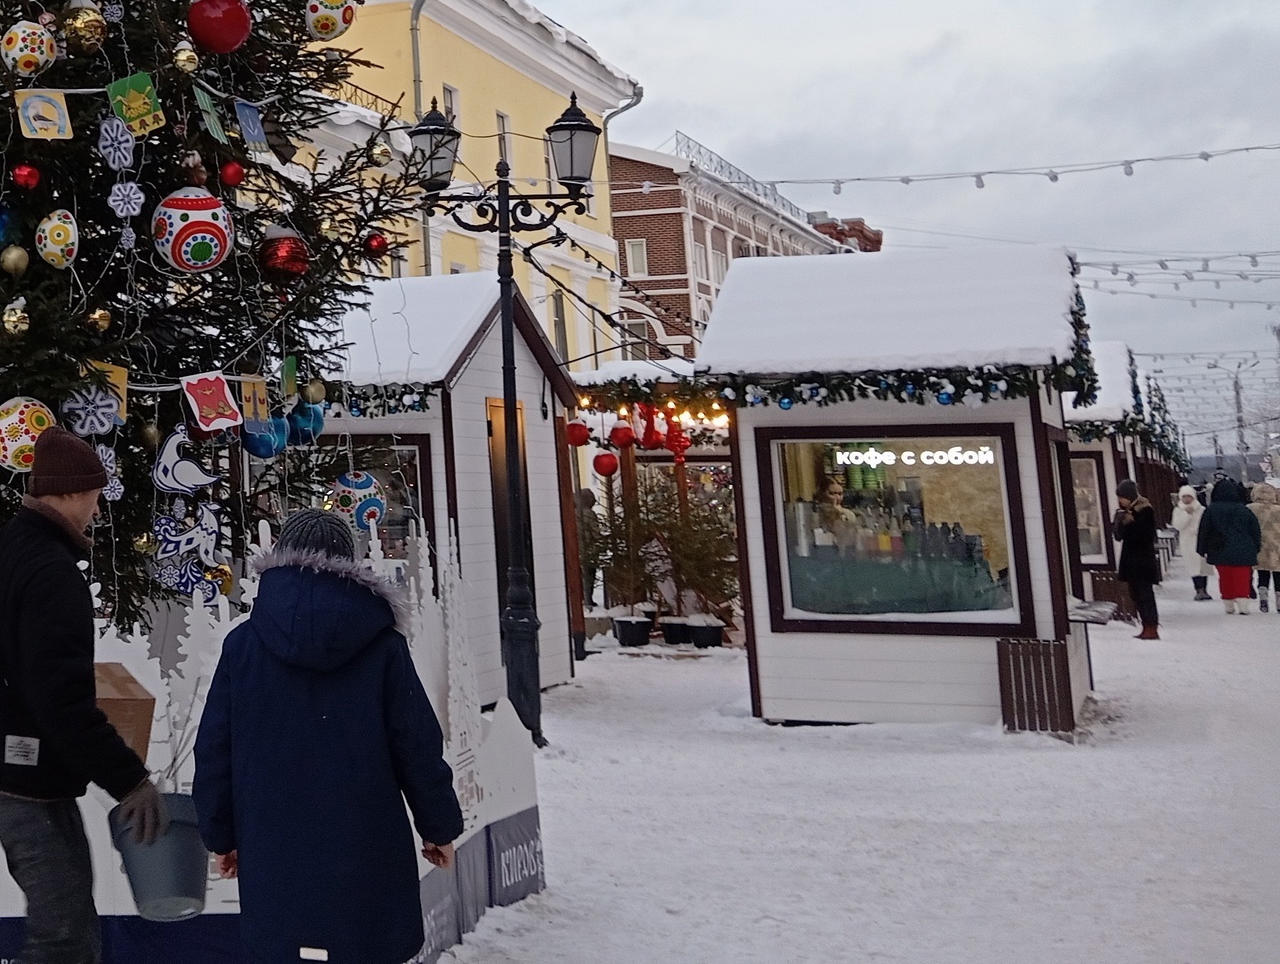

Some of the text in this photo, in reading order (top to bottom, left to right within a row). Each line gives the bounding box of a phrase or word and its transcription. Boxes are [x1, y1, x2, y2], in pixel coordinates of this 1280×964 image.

[836, 446, 994, 469] кофе с собой
